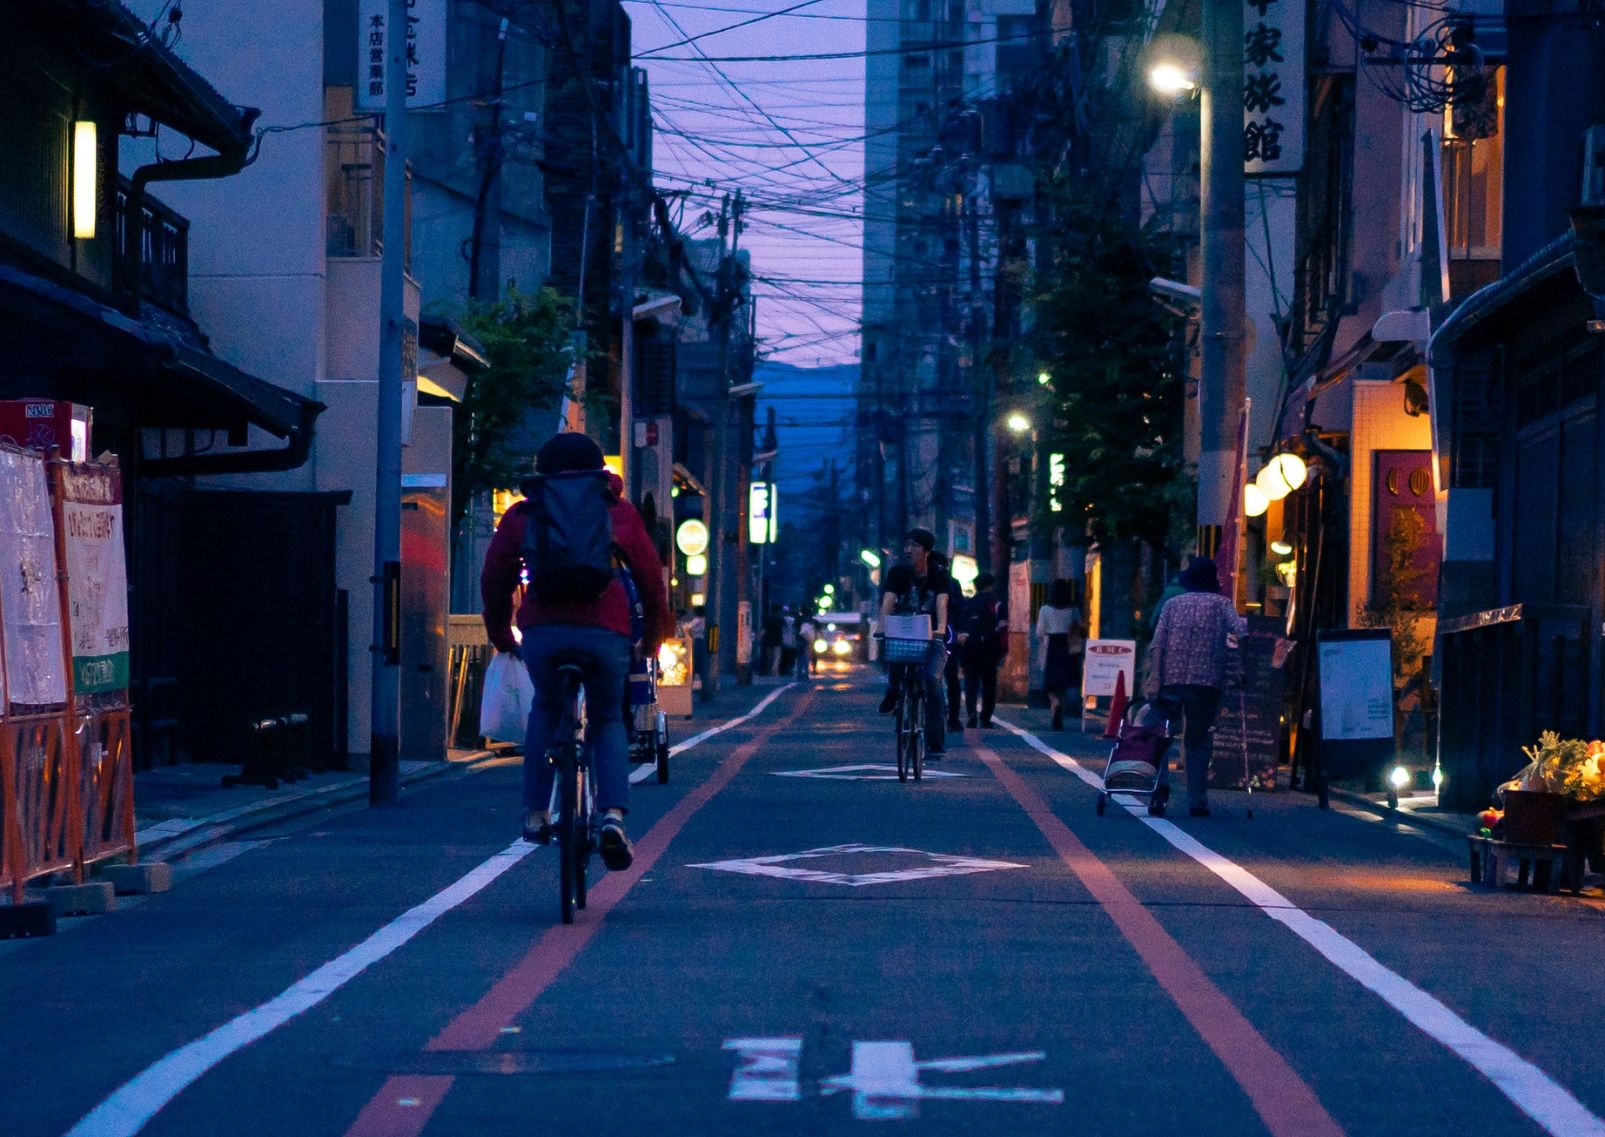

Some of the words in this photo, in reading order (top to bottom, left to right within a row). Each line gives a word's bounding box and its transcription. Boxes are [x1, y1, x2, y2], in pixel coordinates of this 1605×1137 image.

[369, 15, 384, 96] 本店営業部
